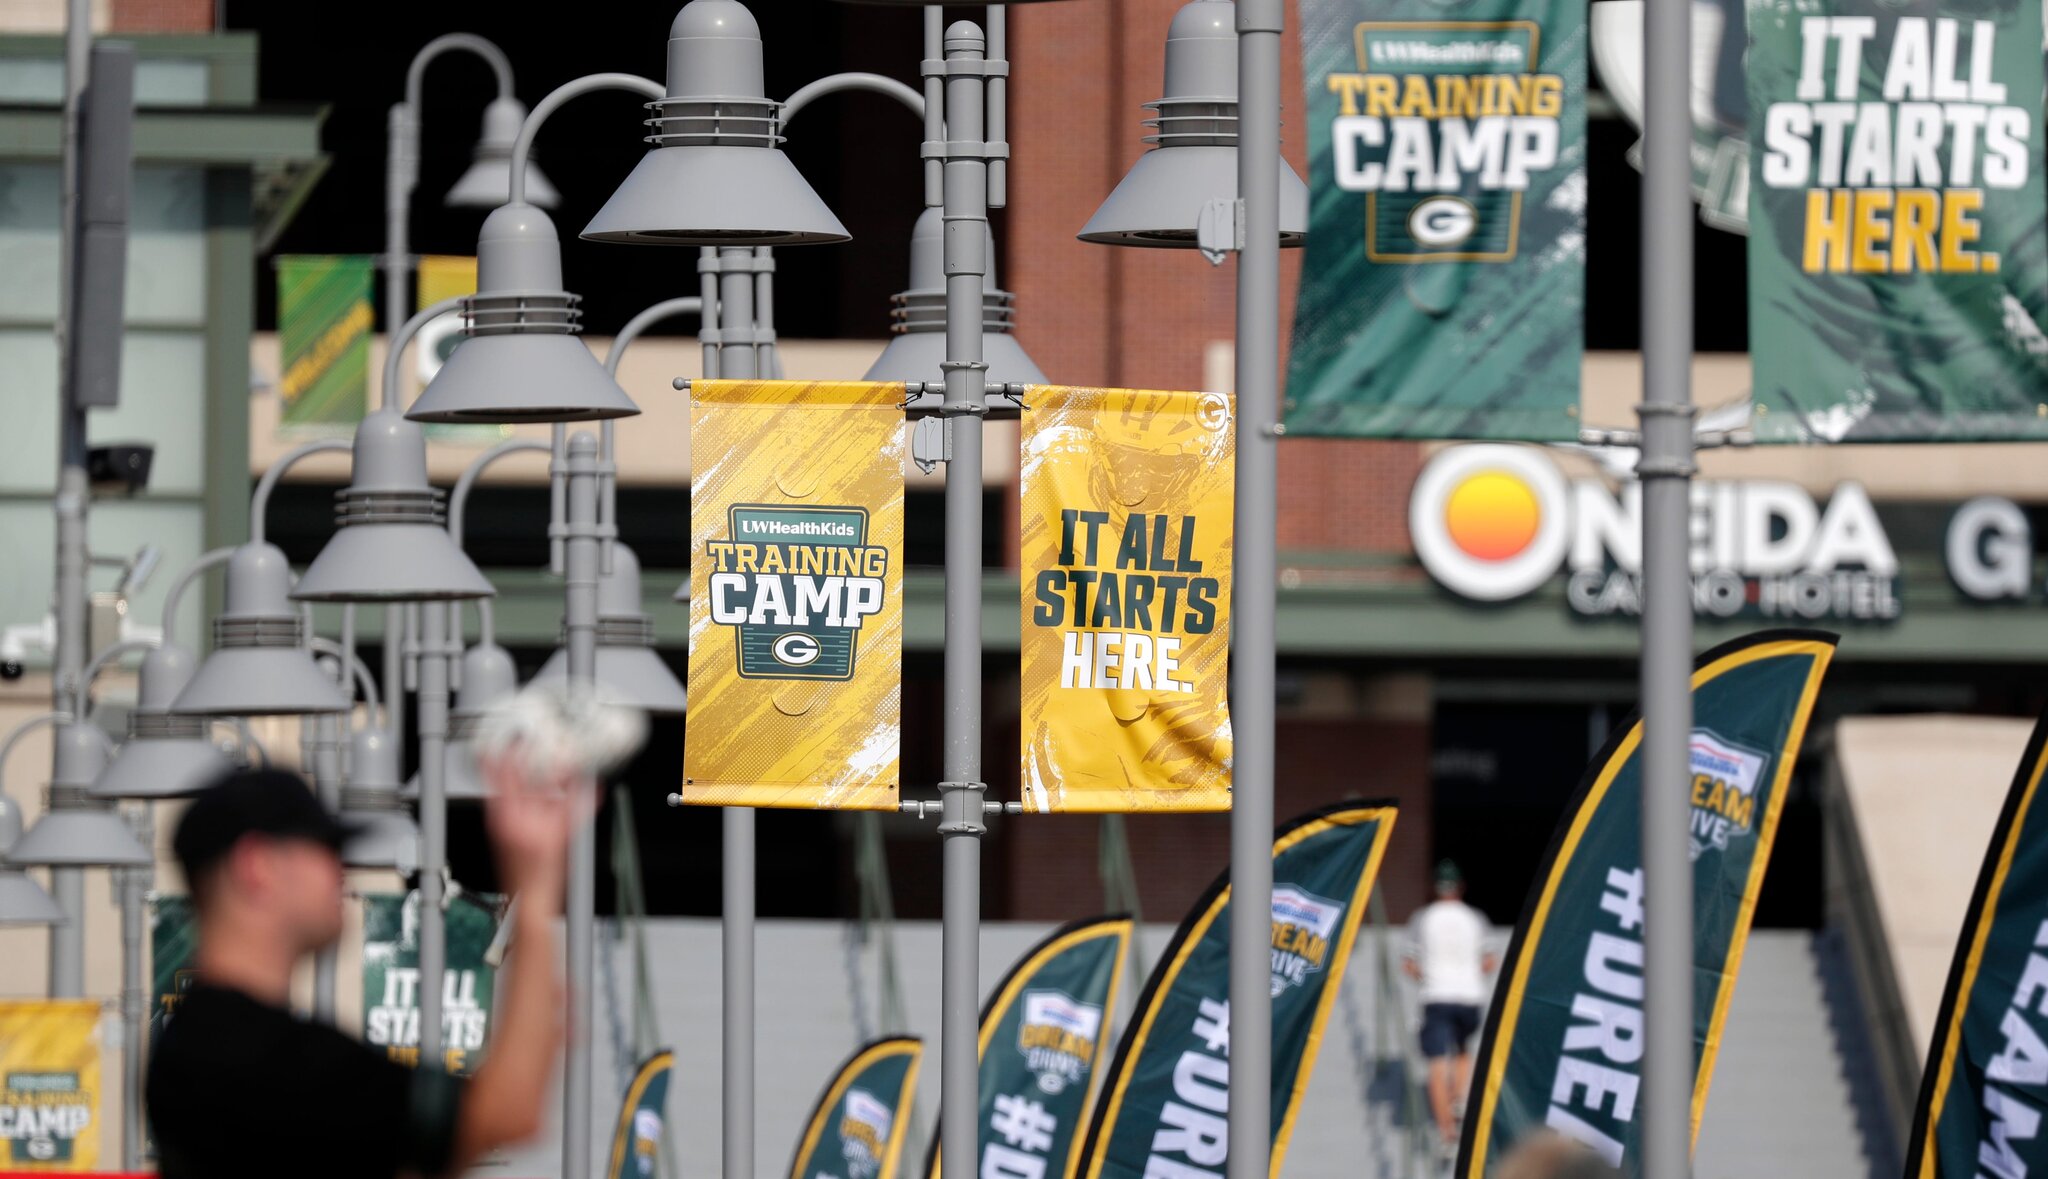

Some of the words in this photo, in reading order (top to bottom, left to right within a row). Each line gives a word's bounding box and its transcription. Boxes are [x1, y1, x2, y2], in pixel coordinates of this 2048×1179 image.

[1797, 16, 1876, 100] IT
[1882, 16, 2008, 103] ALL
[1328, 73, 1564, 118] TRAINING
[1332, 116, 1559, 191] CAMP
[1761, 101, 2031, 189] STARTS
[1409, 198, 1476, 245] G
[1803, 188, 2001, 273] HERE.
[709, 543, 886, 577] TRAINING
[1058, 509, 1109, 567] IT
[1116, 513, 1203, 573] ALL
[711, 573, 883, 628] CAMP
[1033, 570, 1219, 635] STARTS
[774, 633, 819, 665] G
[1061, 632, 1194, 694] HERE.
[383, 966, 420, 1007] IT
[367, 1005, 487, 1051] STATS
